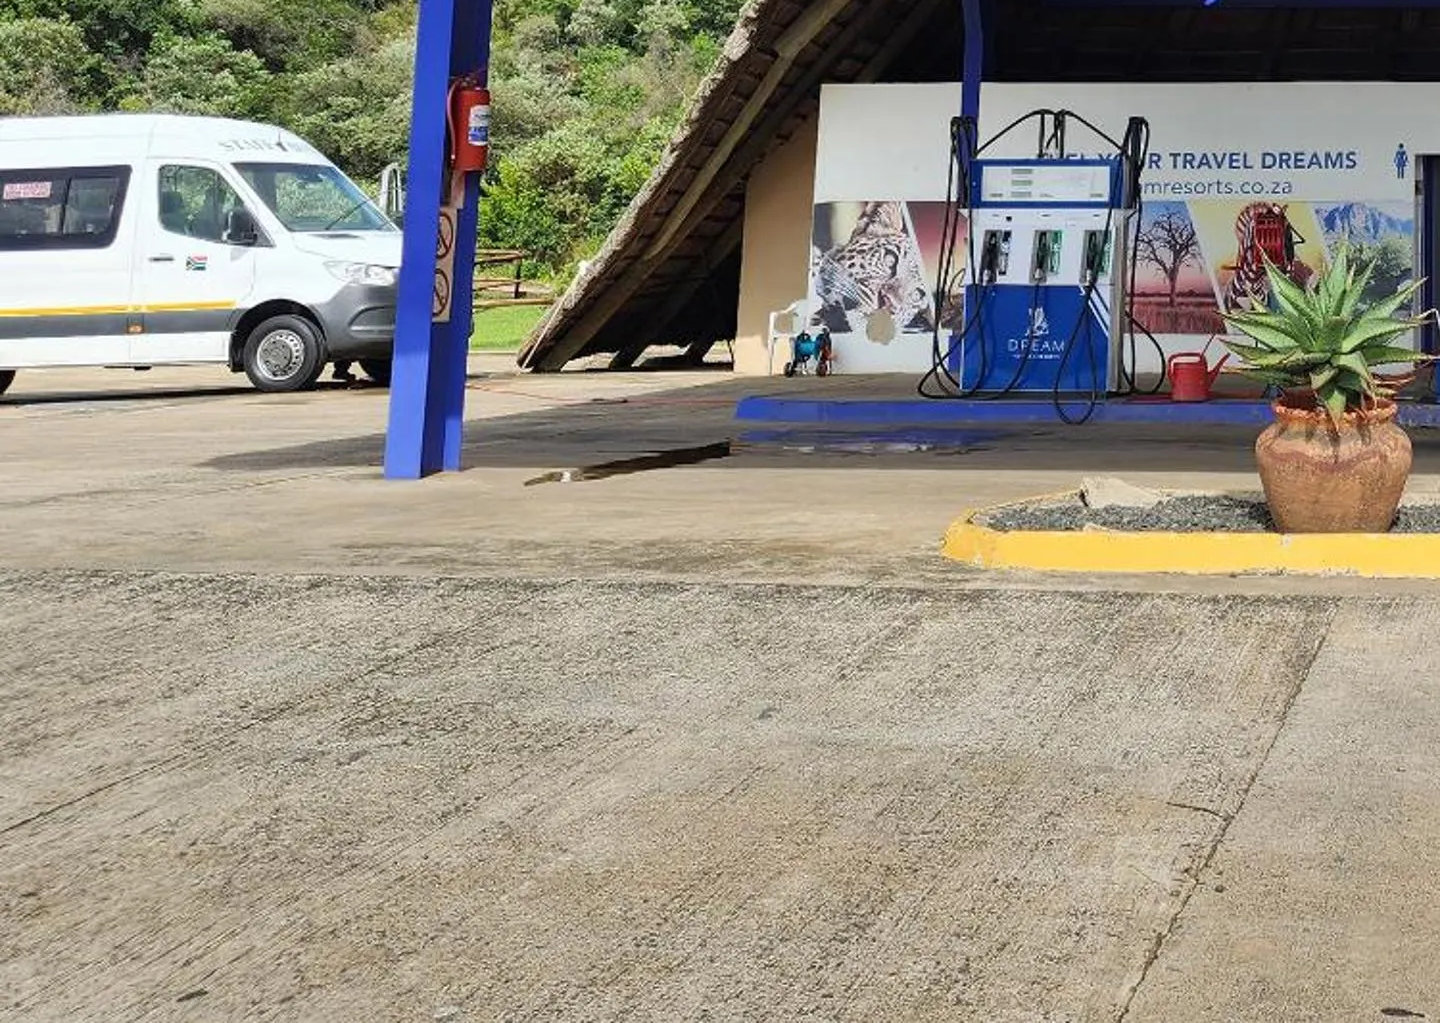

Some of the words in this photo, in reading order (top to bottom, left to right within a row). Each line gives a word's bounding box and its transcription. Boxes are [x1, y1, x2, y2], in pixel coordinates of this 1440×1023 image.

[1169, 152, 1253, 169] TRAVEL
[1261, 152, 1357, 169] DREAMS
[1142, 179, 1292, 195] mresorts.co.za
